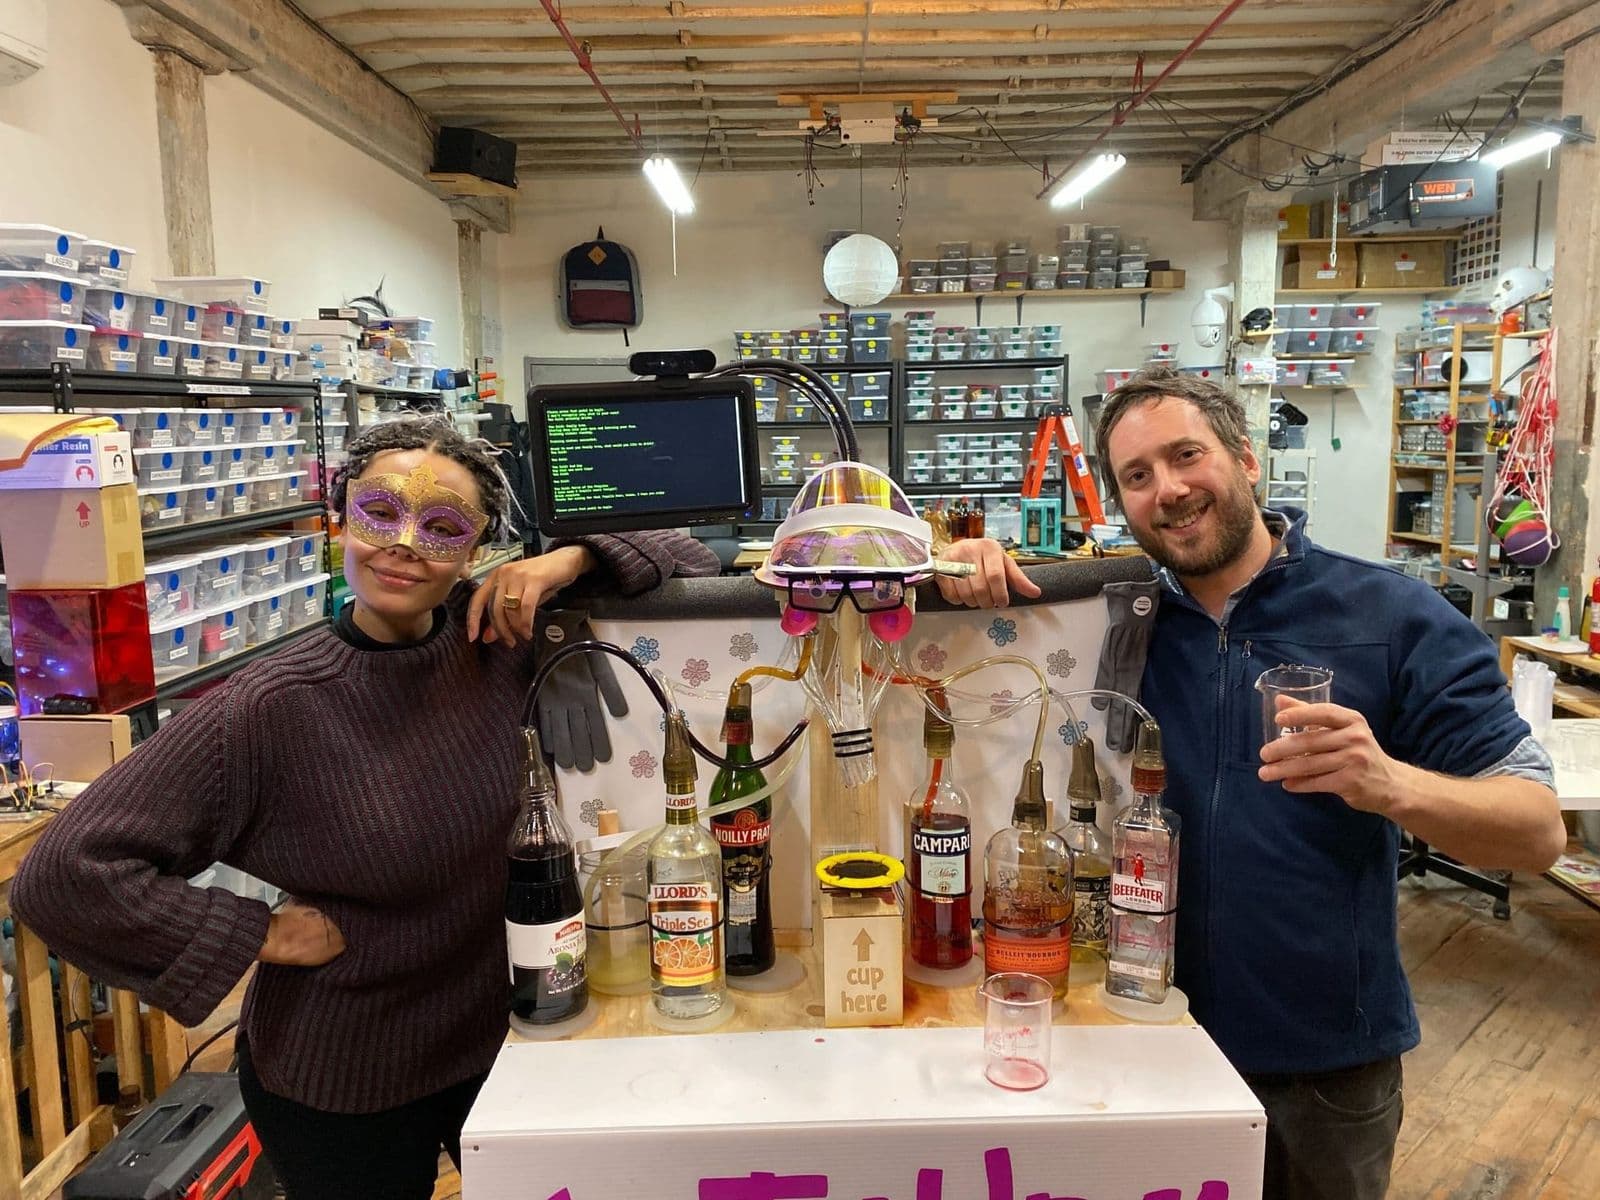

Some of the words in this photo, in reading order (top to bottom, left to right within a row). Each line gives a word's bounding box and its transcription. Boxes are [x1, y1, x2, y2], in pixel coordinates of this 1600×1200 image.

[1423, 183, 1456, 194] WEN
[51, 256, 74, 268] LASERS
[61, 440, 89, 451] Resin
[79, 520, 90, 528] UP
[715, 827, 749, 844] NOILLY
[750, 824, 771, 842] PRAT
[913, 833, 970, 853] CAMPARI
[654, 886, 708, 900] LLORD'S
[1113, 883, 1164, 905] BEEFEATER
[654, 914, 686, 932] Triple
[687, 917, 710, 930] Sec
[846, 968, 884, 990] cup
[840, 991, 888, 1013] here
